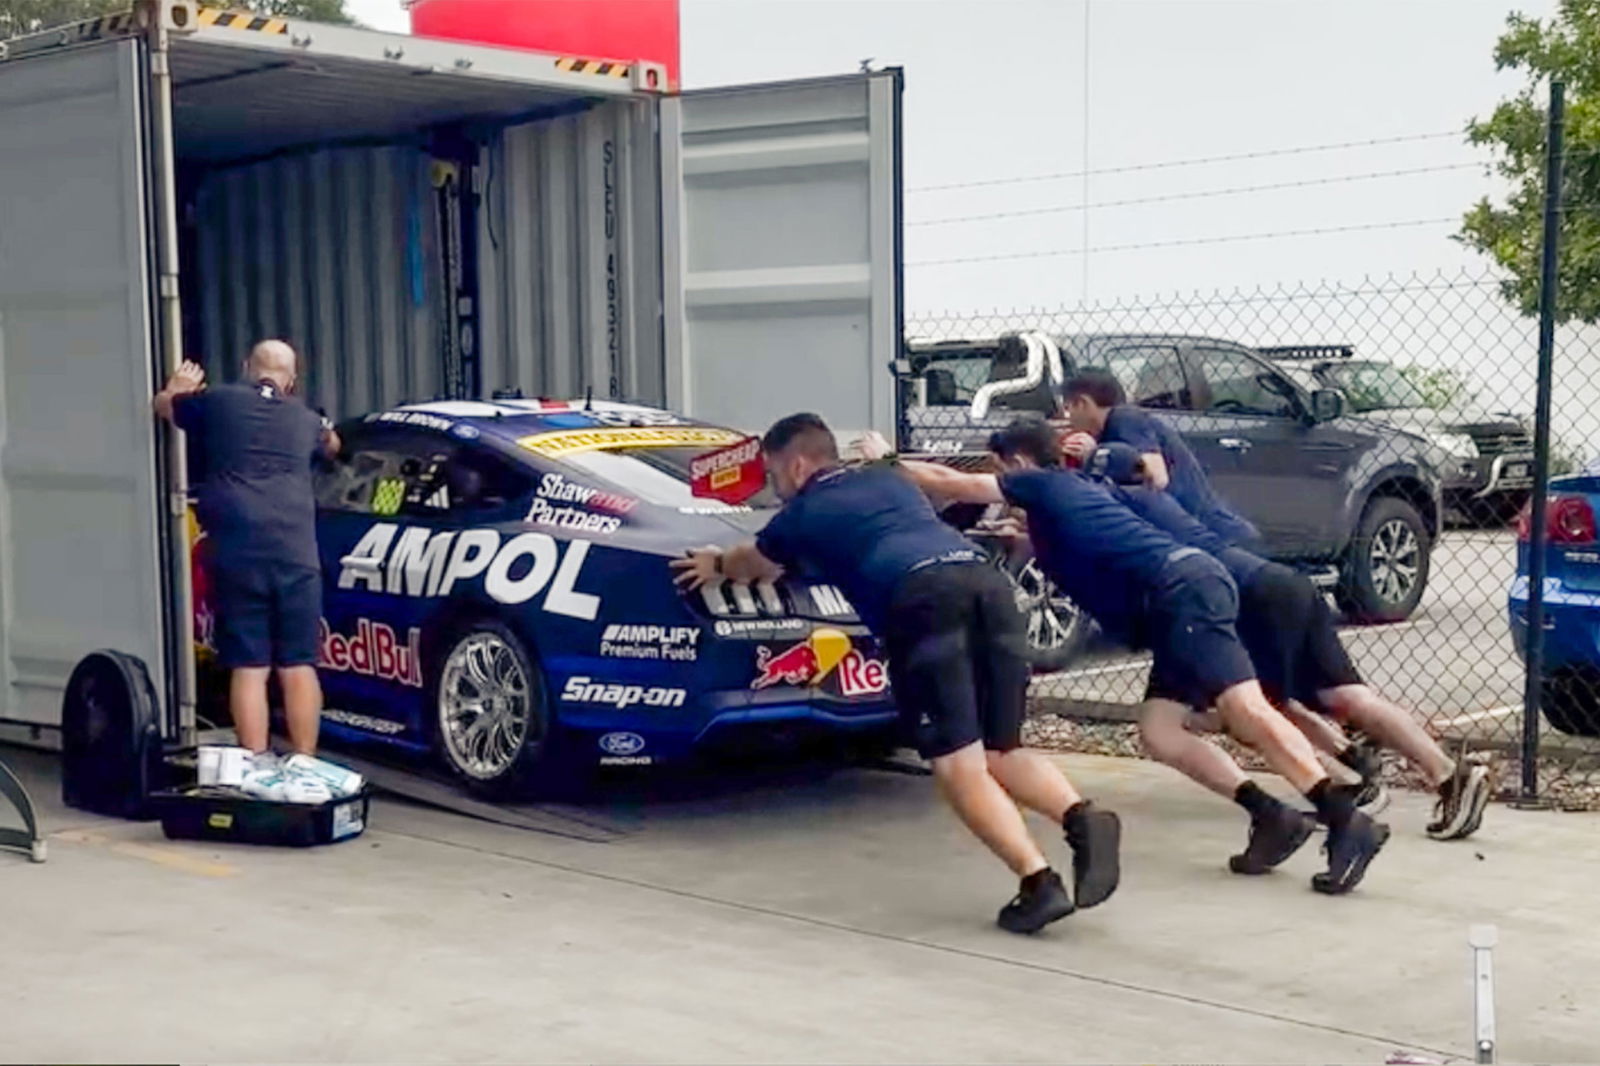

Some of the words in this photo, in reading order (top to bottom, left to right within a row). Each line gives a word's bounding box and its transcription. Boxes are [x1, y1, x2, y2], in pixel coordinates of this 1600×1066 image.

[537, 473, 597, 504] Shaw
[524, 497, 621, 534] Partners
[338, 522, 601, 621] AMPOL
[600, 641, 658, 659] Premium
[661, 644, 697, 661] Fuels
[617, 625, 701, 645] AMPLIFY
[838, 648, 889, 696] Re
[561, 676, 687, 709] Snap-on
